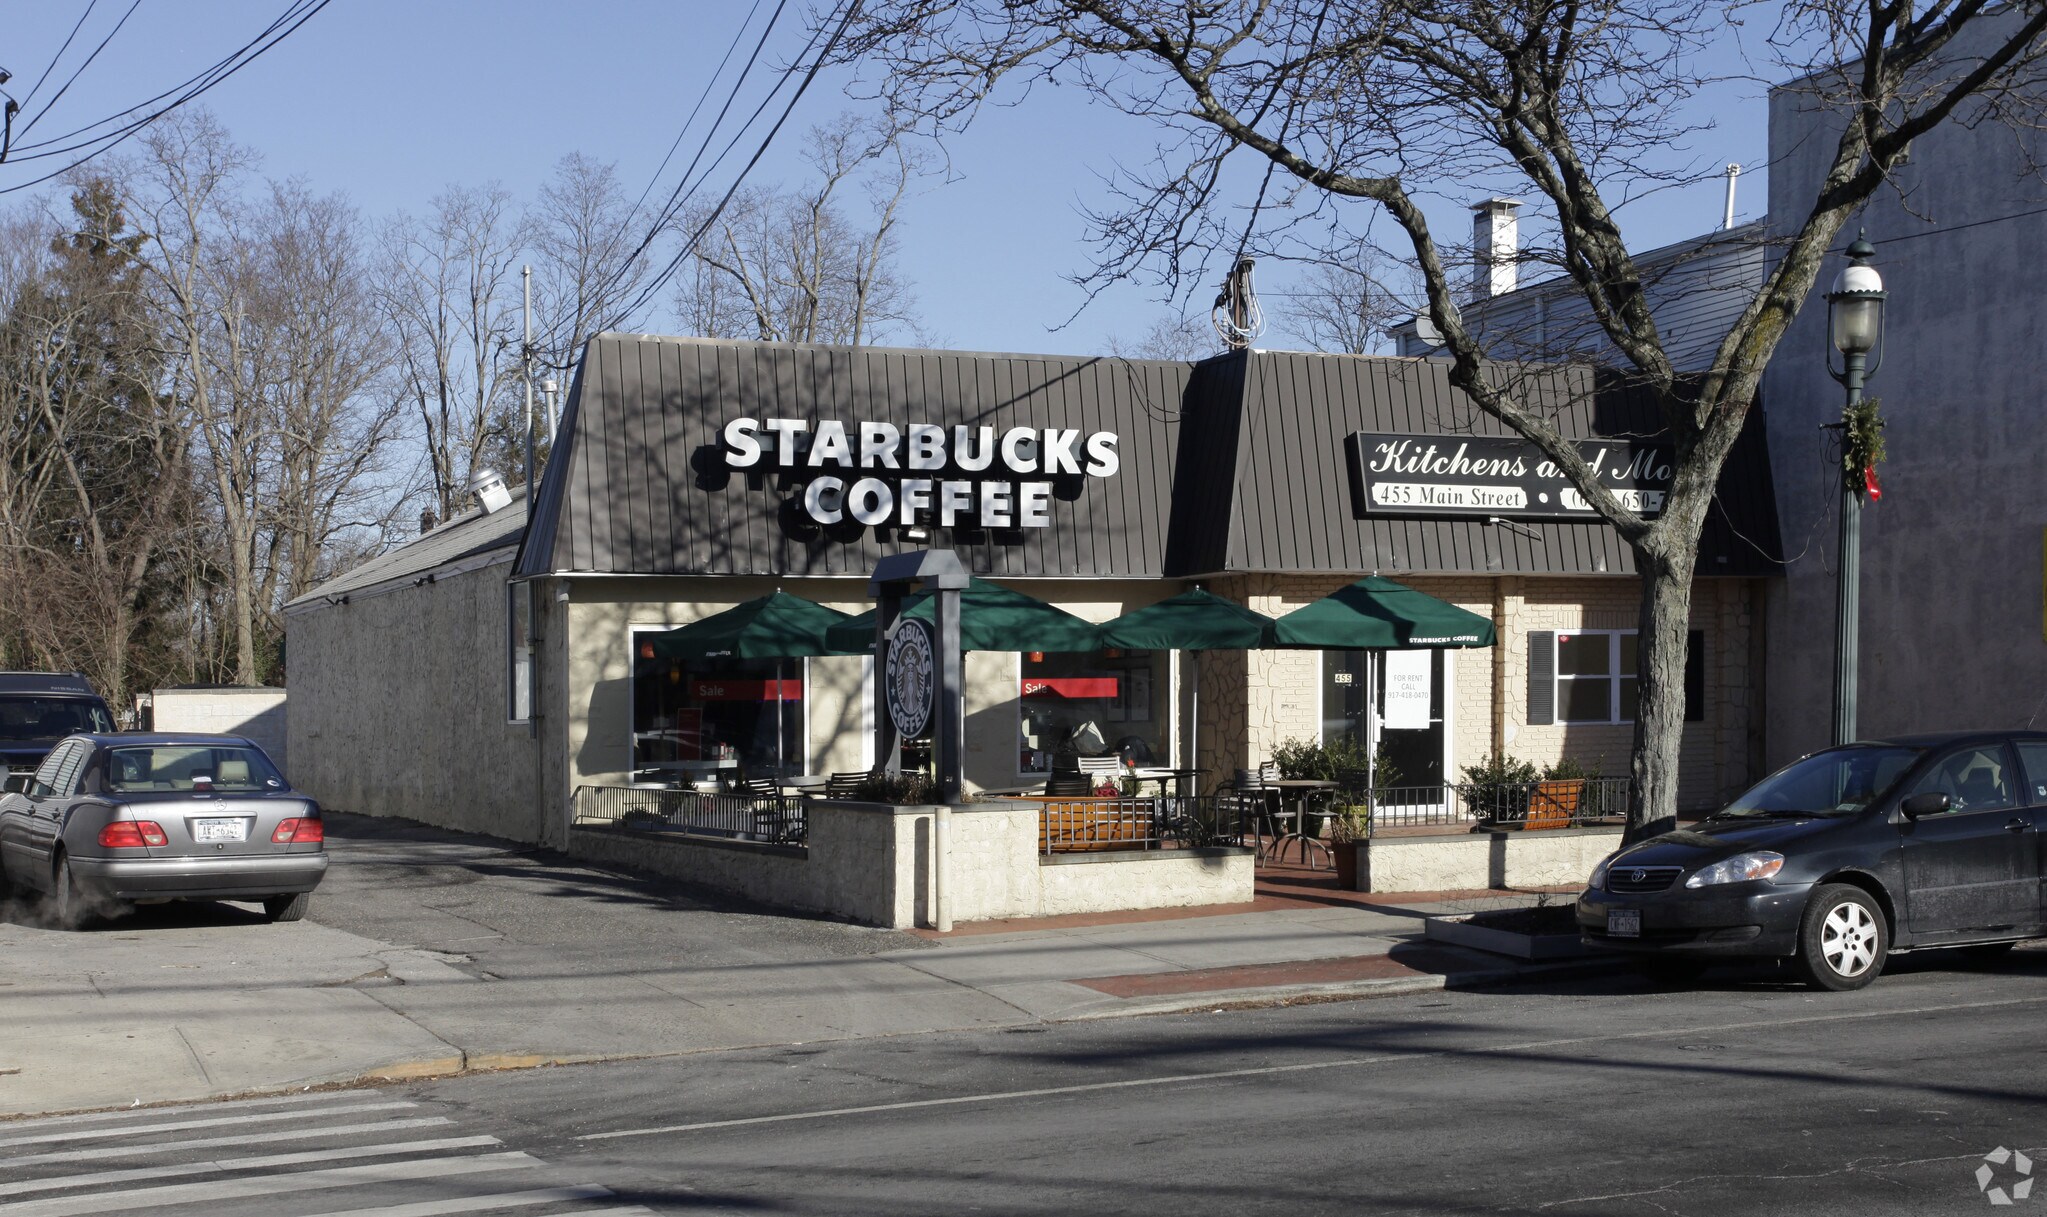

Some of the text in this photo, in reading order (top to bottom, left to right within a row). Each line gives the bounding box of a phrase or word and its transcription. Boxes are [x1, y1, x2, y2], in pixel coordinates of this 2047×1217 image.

[724, 417, 1119, 477] STARBUCKS
[1369, 439, 1673, 480] Kitchens ad Mo
[804, 476, 1051, 528] COFFEE
[1380, 485, 1520, 506] 455 Main Street
[1409, 636, 1451, 644] STARBUCKS
[888, 624, 931, 677] STARBUCKS
[1335, 674, 1351, 682] 455
[1393, 674, 1423, 682] FOR RENT
[1401, 682, 1416, 690] CALL
[699, 684, 724, 697] Sale
[1025, 682, 1048, 694] Sale
[892, 702, 927, 733] COFFEE
